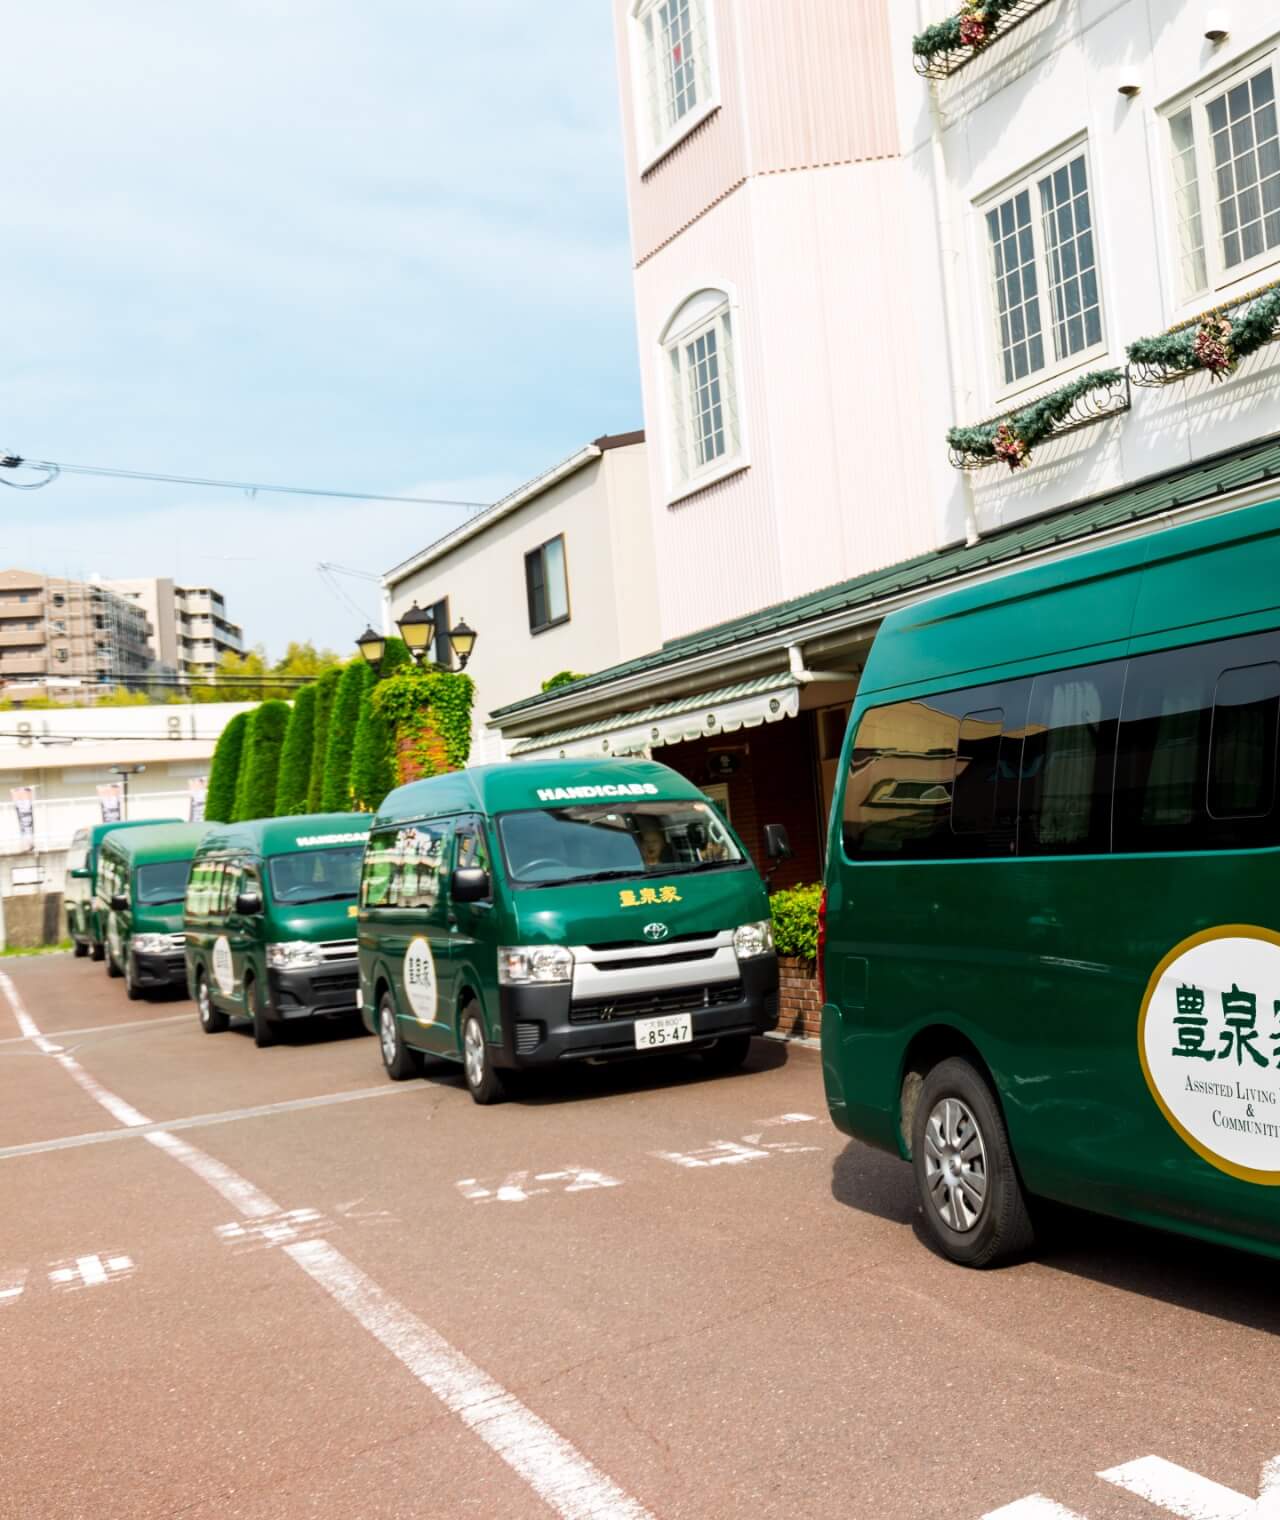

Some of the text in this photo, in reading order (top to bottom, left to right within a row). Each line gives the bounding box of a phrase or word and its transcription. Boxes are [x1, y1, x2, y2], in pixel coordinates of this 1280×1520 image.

[536, 783, 659, 801] HANDICABS
[648, 1025, 688, 1045] 85-47
[1245, 1103, 1255, 1118] &
